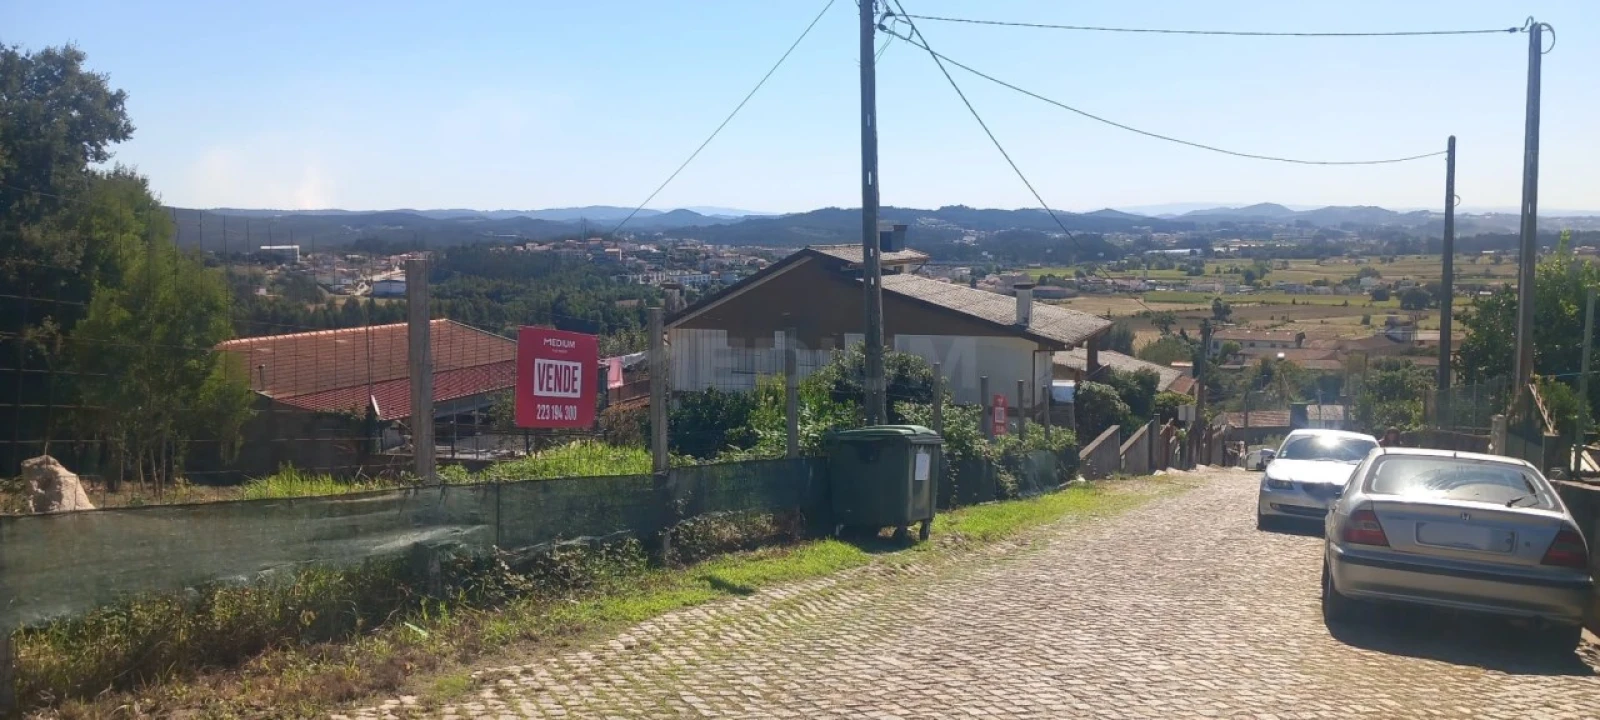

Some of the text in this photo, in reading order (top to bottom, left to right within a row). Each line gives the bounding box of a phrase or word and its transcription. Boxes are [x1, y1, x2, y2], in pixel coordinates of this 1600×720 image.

[543, 338, 576, 349] MEDIUM
[538, 362, 579, 393] VENDE
[536, 404, 577, 420] 223 194 300
